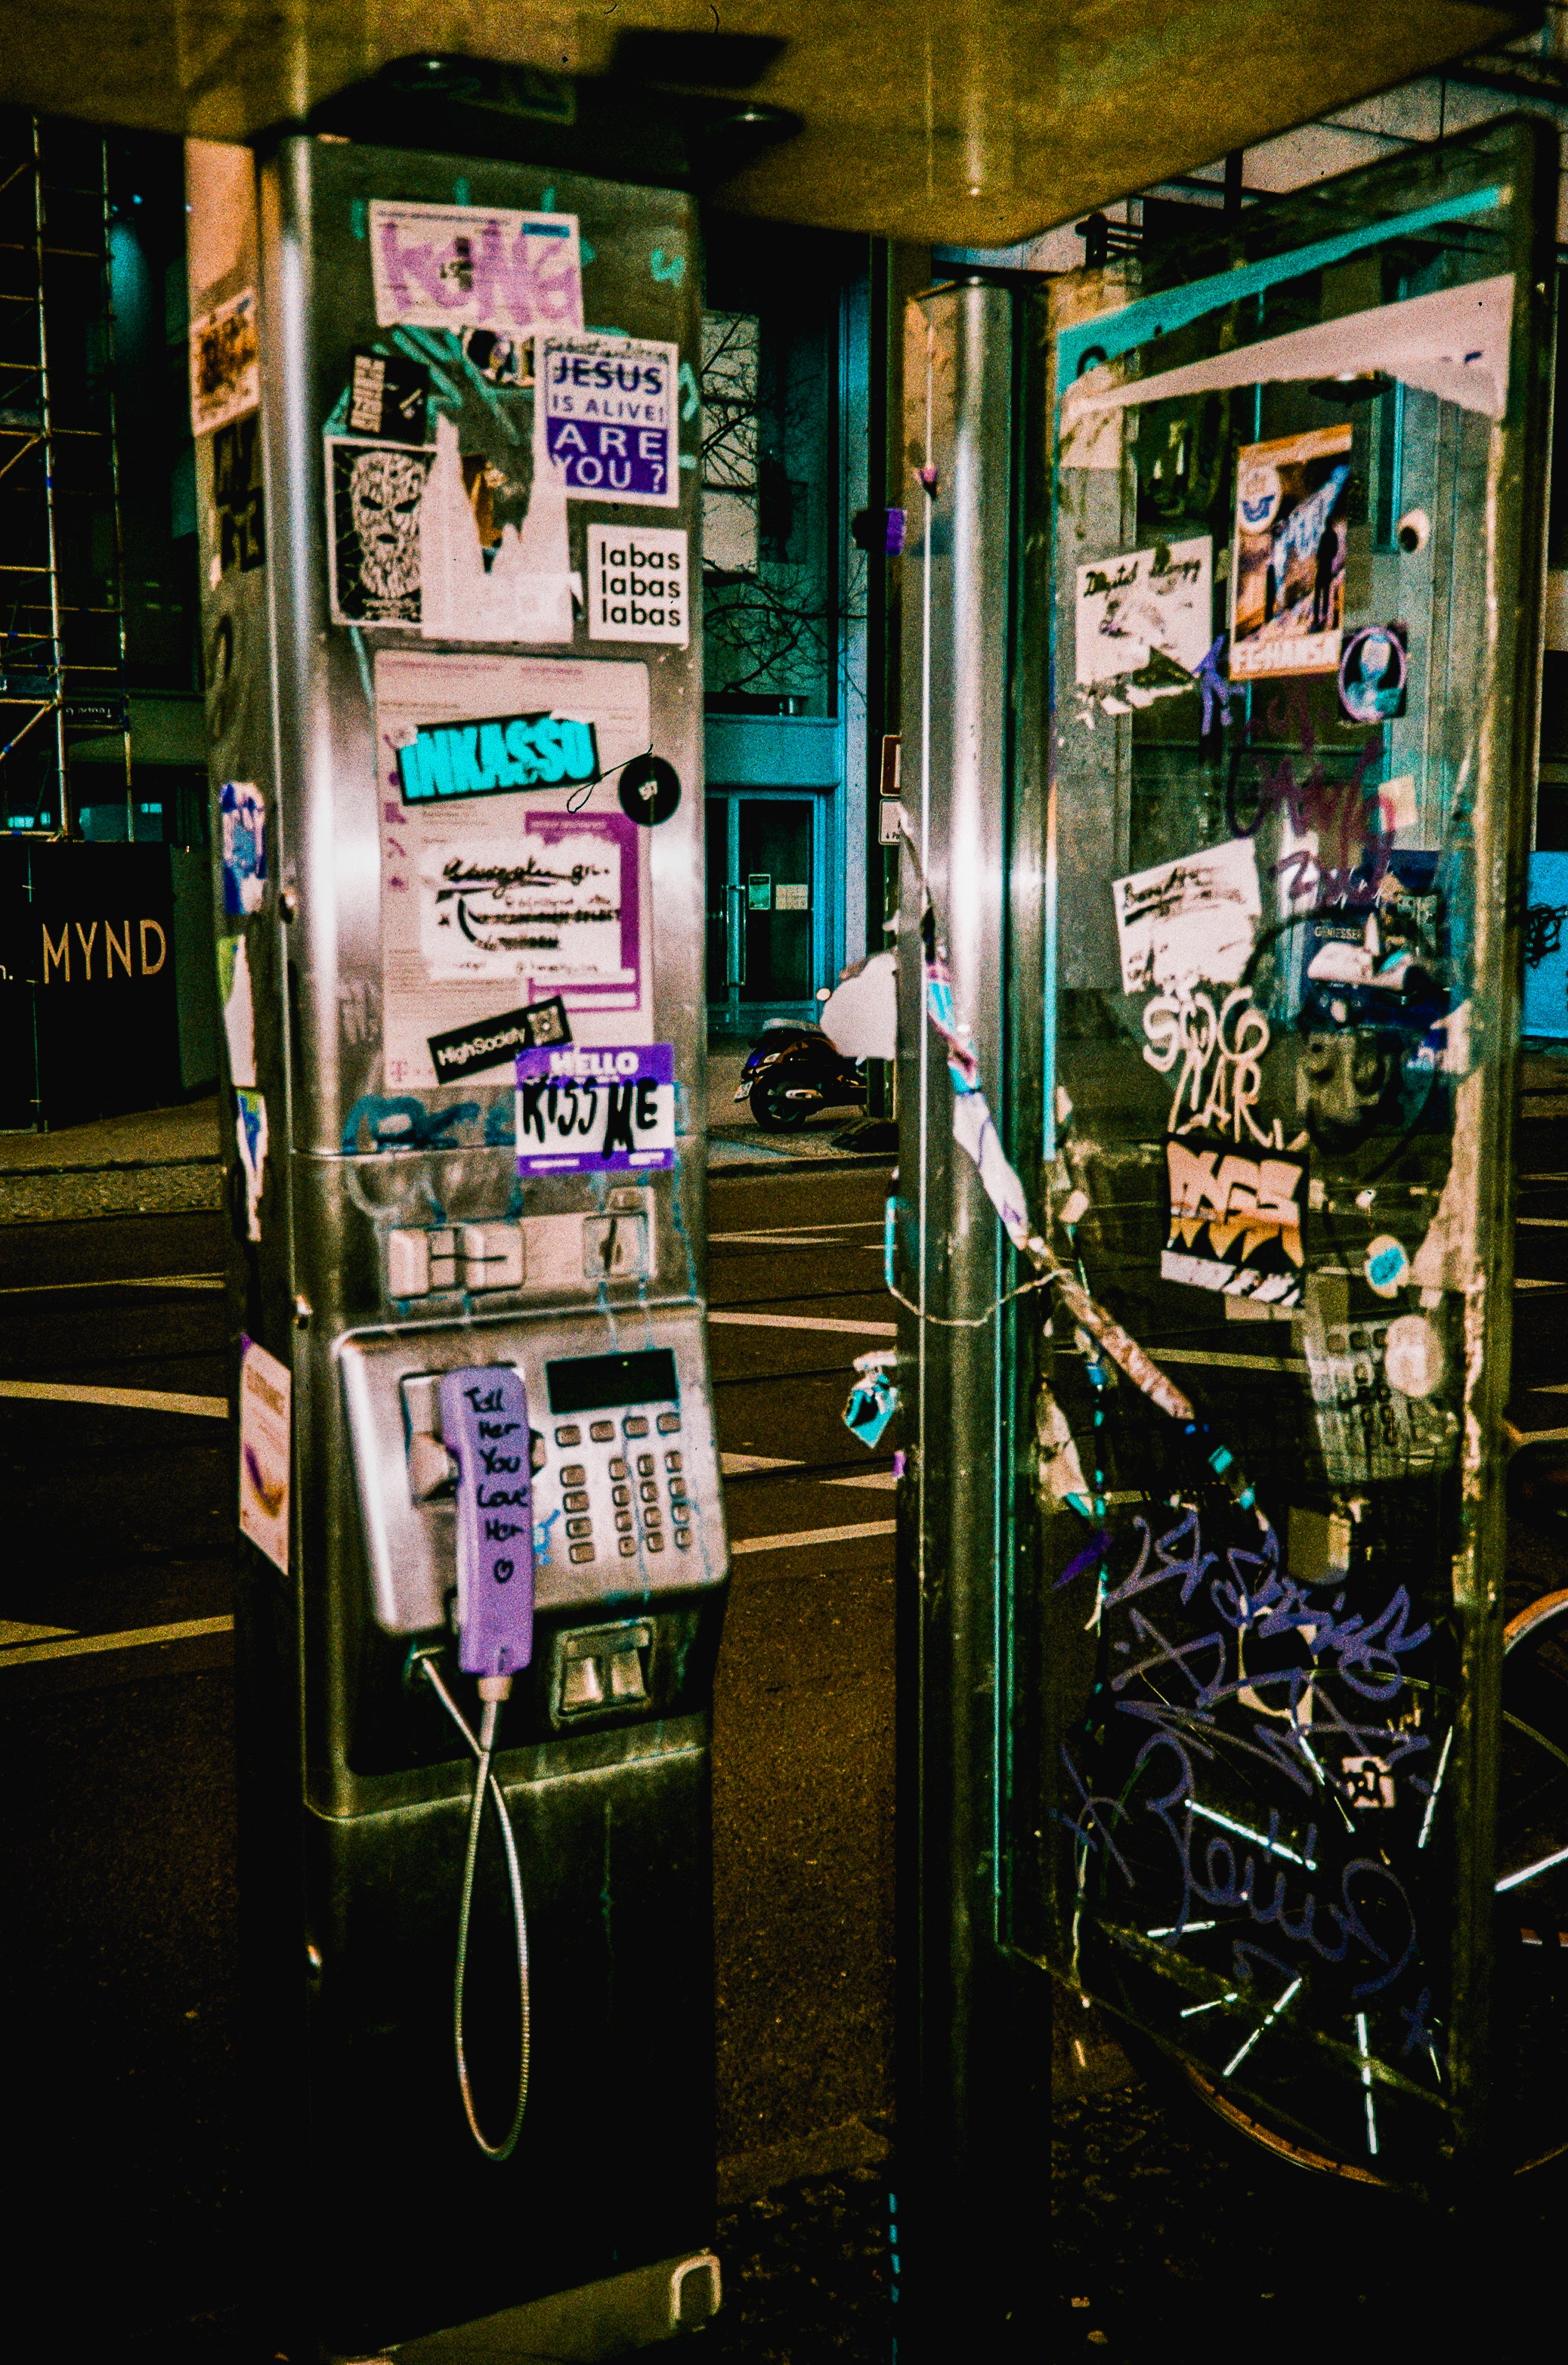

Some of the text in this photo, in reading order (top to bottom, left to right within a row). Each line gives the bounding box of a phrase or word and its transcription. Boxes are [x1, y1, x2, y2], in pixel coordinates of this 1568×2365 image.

[552, 356, 663, 396] JESUS
[552, 394, 664, 422] IS ALIVE!
[553, 422, 663, 462] ARE
[602, 541, 680, 570] labas
[602, 570, 680, 598] labas
[602, 598, 681, 627] labas
[399, 718, 595, 799] INKASSO
[42, 919, 166, 984] MYND
[549, 1050, 640, 1075] HELLO
[522, 1074, 598, 1143] KISS
[478, 1446, 521, 1475] You
